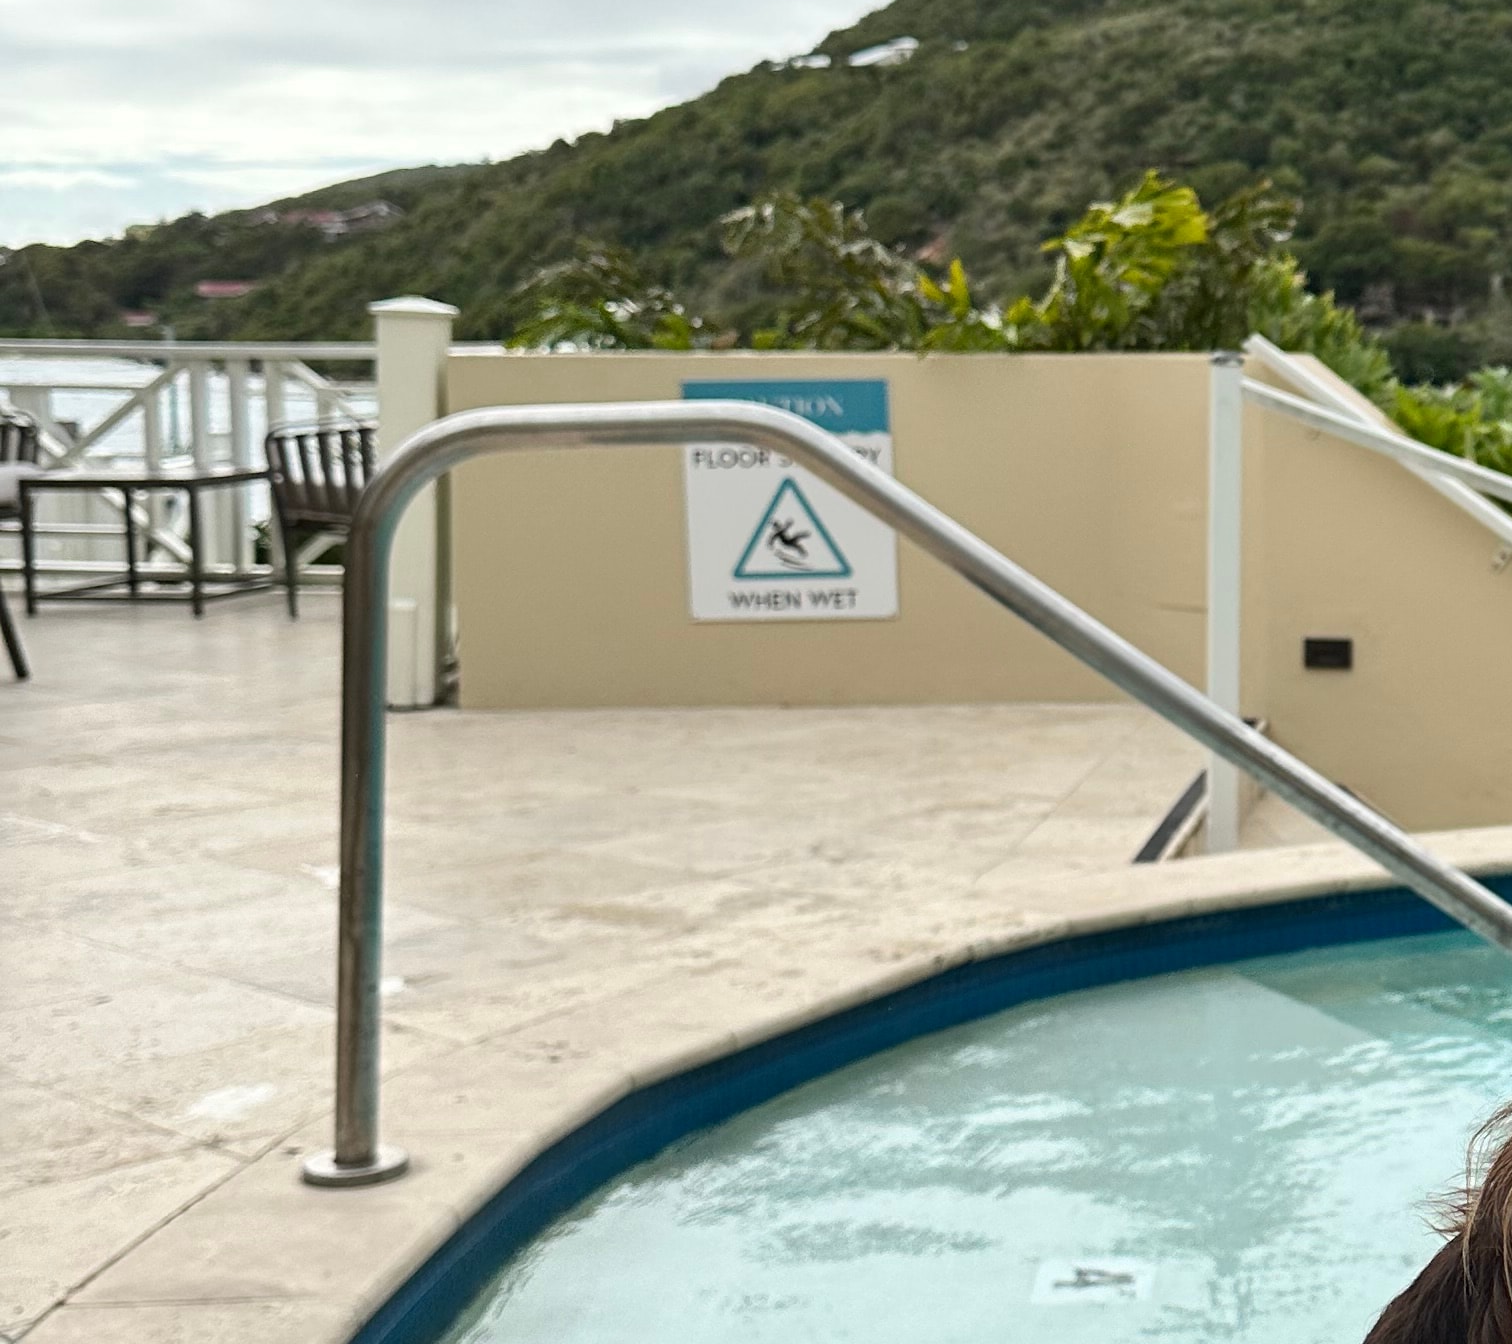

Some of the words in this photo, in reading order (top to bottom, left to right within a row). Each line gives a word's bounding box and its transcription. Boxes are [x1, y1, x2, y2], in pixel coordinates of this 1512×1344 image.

[693, 446, 771, 469] FLOOR
[729, 590, 802, 611] WHEN
[809, 588, 859, 610] WET
